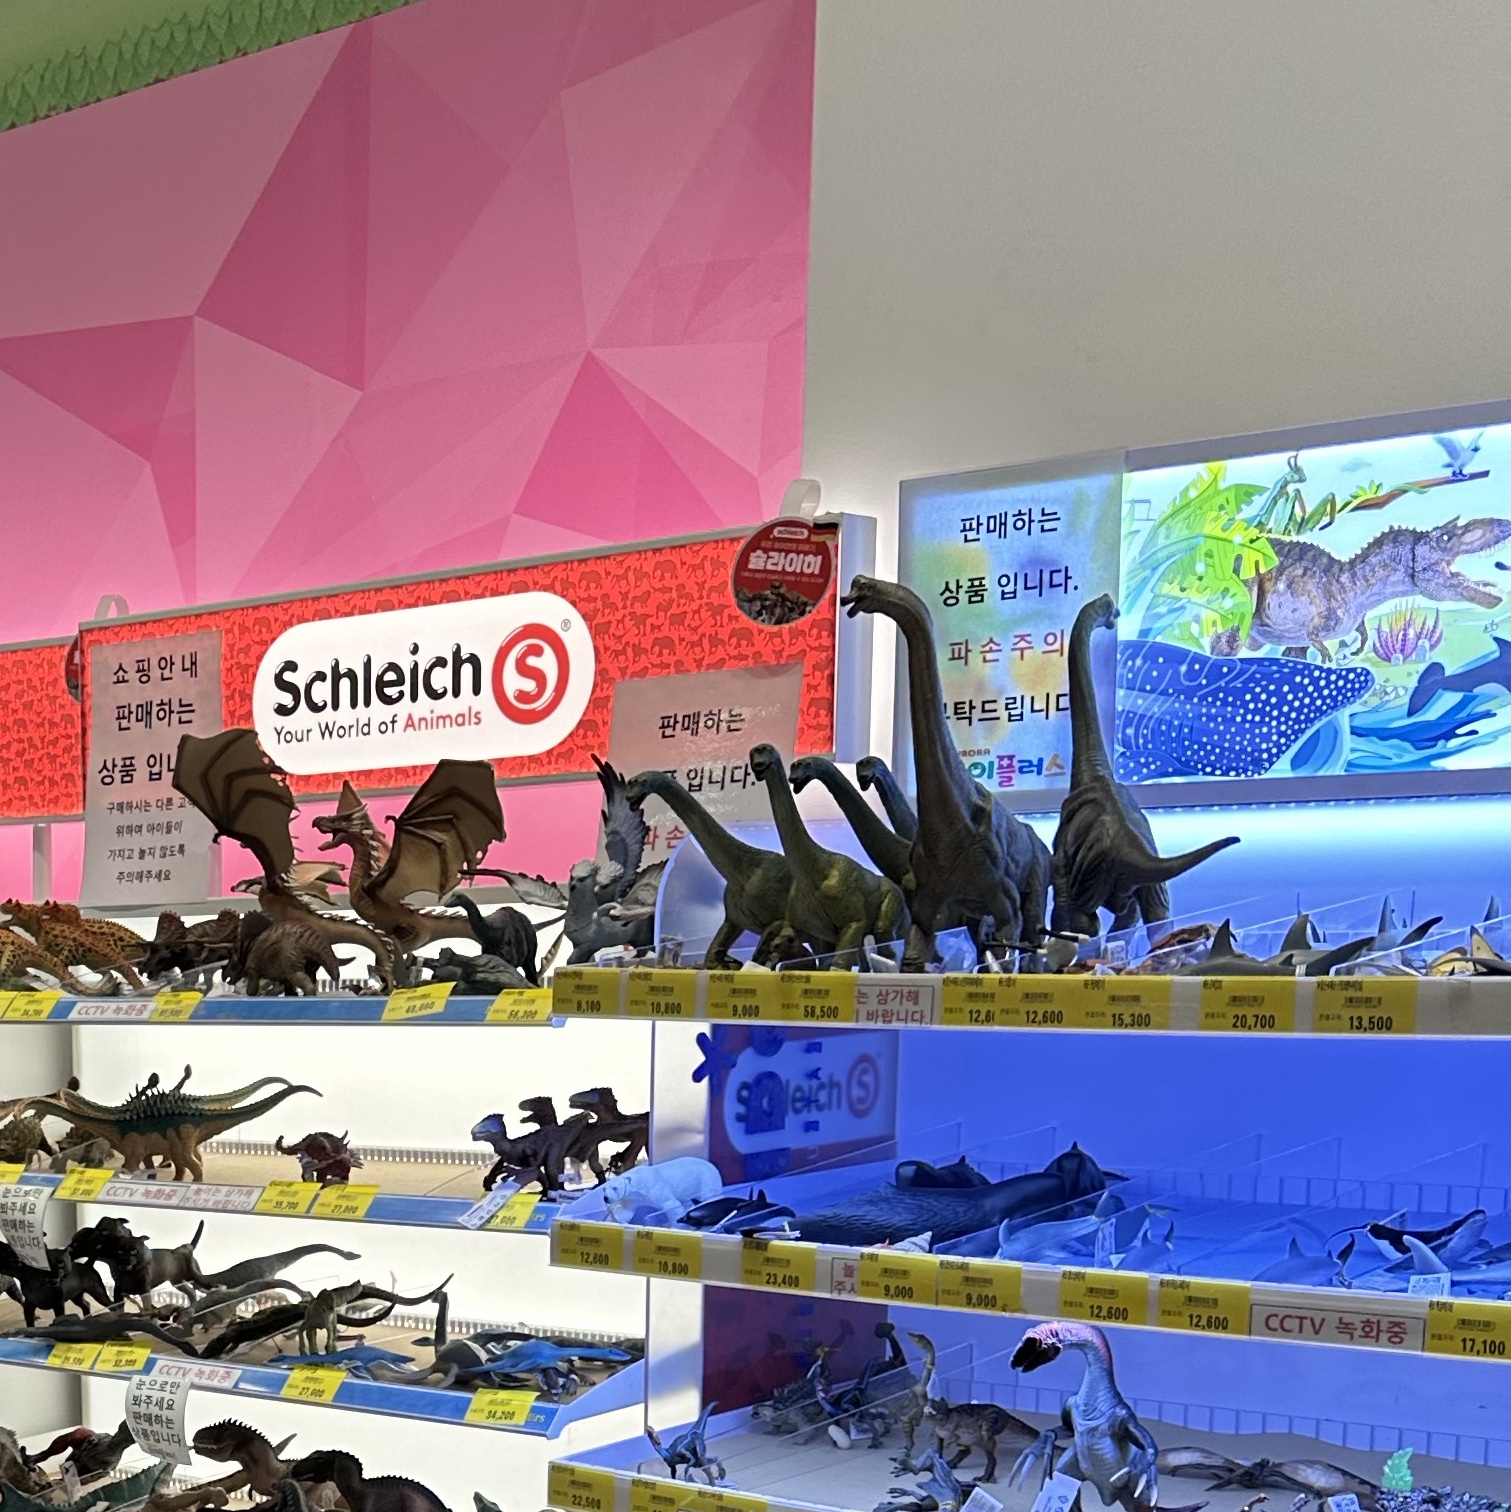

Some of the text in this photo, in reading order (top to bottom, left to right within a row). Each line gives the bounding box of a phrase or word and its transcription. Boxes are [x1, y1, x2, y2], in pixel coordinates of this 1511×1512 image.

[960, 507, 1061, 543] 판매하는
[939, 566, 1079, 607] 상품 입니다.
[273, 642, 482, 717] Schleich
[115, 698, 196, 732] 판매하는
[659, 708, 746, 739] 판매하는
[274, 706, 482, 745] Your World of Animals
[97, 755, 137, 787] 상품
[106, 798, 175, 815] 구매하시는 다른
[146, 820, 183, 835] 아이들이
[107, 847, 136, 860] 가지고
[116, 869, 172, 884] 주의해주세요
[876, 989, 920, 1006] 삼가해
[77, 1002, 108, 1015] CCTV
[112, 1003, 149, 1018] 녹화중
[576, 1000, 601, 1013] 8,100
[650, 1001, 682, 1015] 10,800
[732, 1003, 760, 1018] 9,000
[803, 1003, 839, 1019] 58,500
[867, 1008, 931, 1026] 바랍니다.
[1025, 1010, 1064, 1025] 12,600
[1111, 1013, 1151, 1028] 15,300
[1232, 1014, 1276, 1029] 20,700
[1348, 1015, 1393, 1031] 13,500
[105, 1186, 179, 1202] CCTV 녹화중
[658, 1260, 689, 1276] 10,800
[765, 1273, 799, 1289] 23,400
[884, 1284, 914, 1300] 9,000
[965, 1293, 997, 1309] 9,000
[1088, 1304, 1129, 1322] 12,600
[1188, 1313, 1229, 1331] 12,600
[1264, 1312, 1409, 1346] CCTV 녹화중
[1460, 1338, 1507, 1356] 17,100
[159, 1364, 231, 1384] CCTV 녹화중
[135, 1378, 181, 1395] 눈으로만
[132, 1395, 175, 1412] 봐주세요
[132, 1411, 175, 1430] 판매하는
[572, 1494, 602, 1511] 22,500
